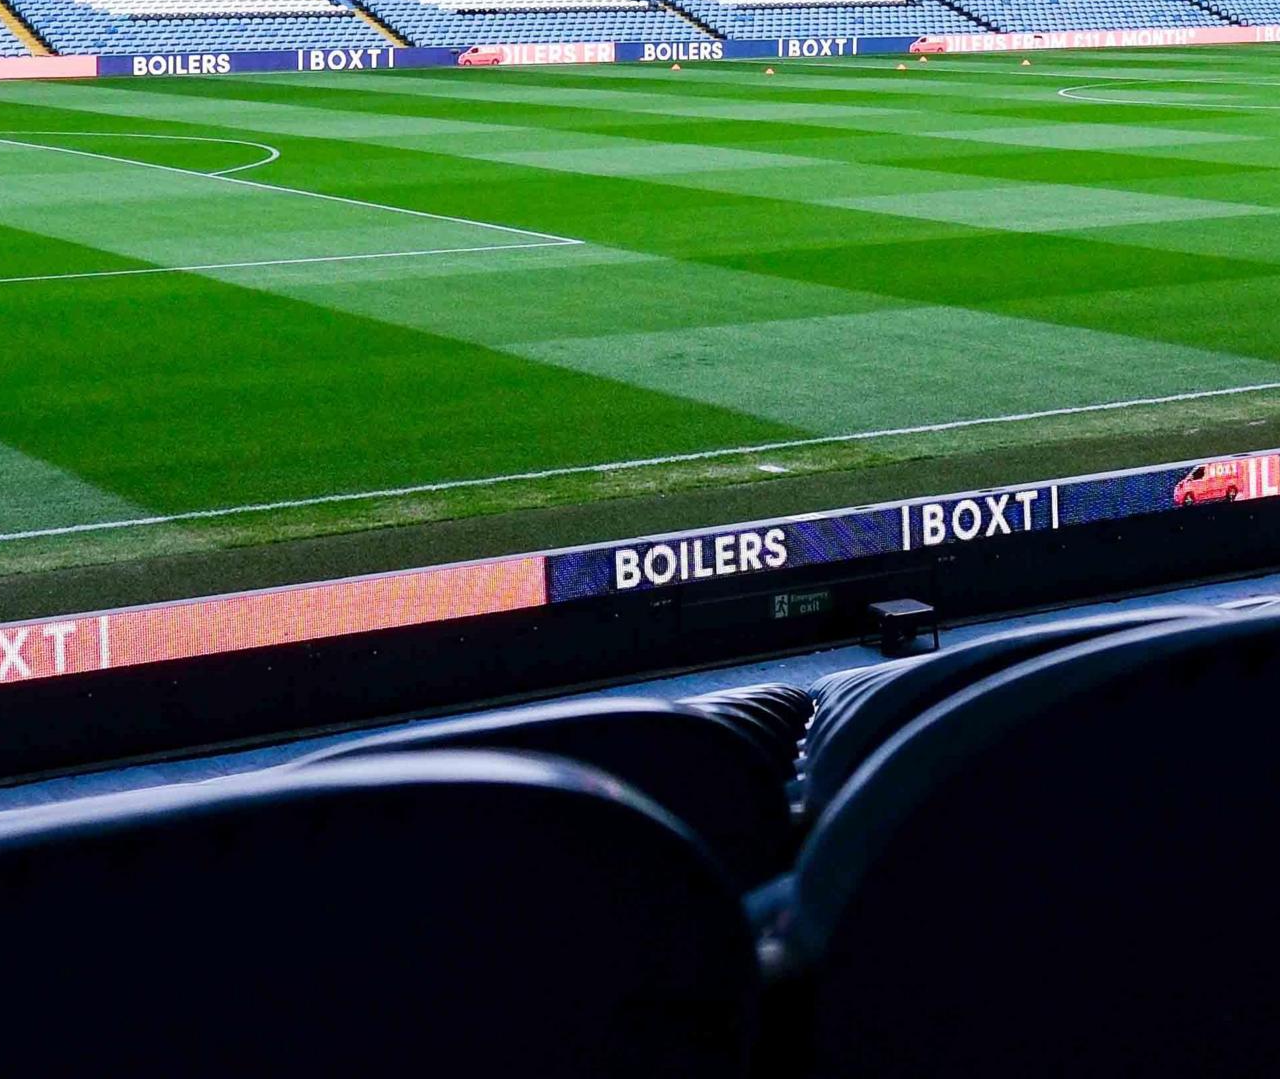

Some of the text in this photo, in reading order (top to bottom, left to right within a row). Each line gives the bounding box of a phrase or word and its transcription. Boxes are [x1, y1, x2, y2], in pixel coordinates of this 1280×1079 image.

[1012, 33, 1066, 50] FROM
[1074, 32, 1100, 48] £11
[1102, 31, 1116, 47] A
[643, 43, 723, 61] BOILERS
[133, 54, 231, 75] BOILERS
[615, 528, 787, 589] BOILERS
[800, 600, 820, 613] exit
